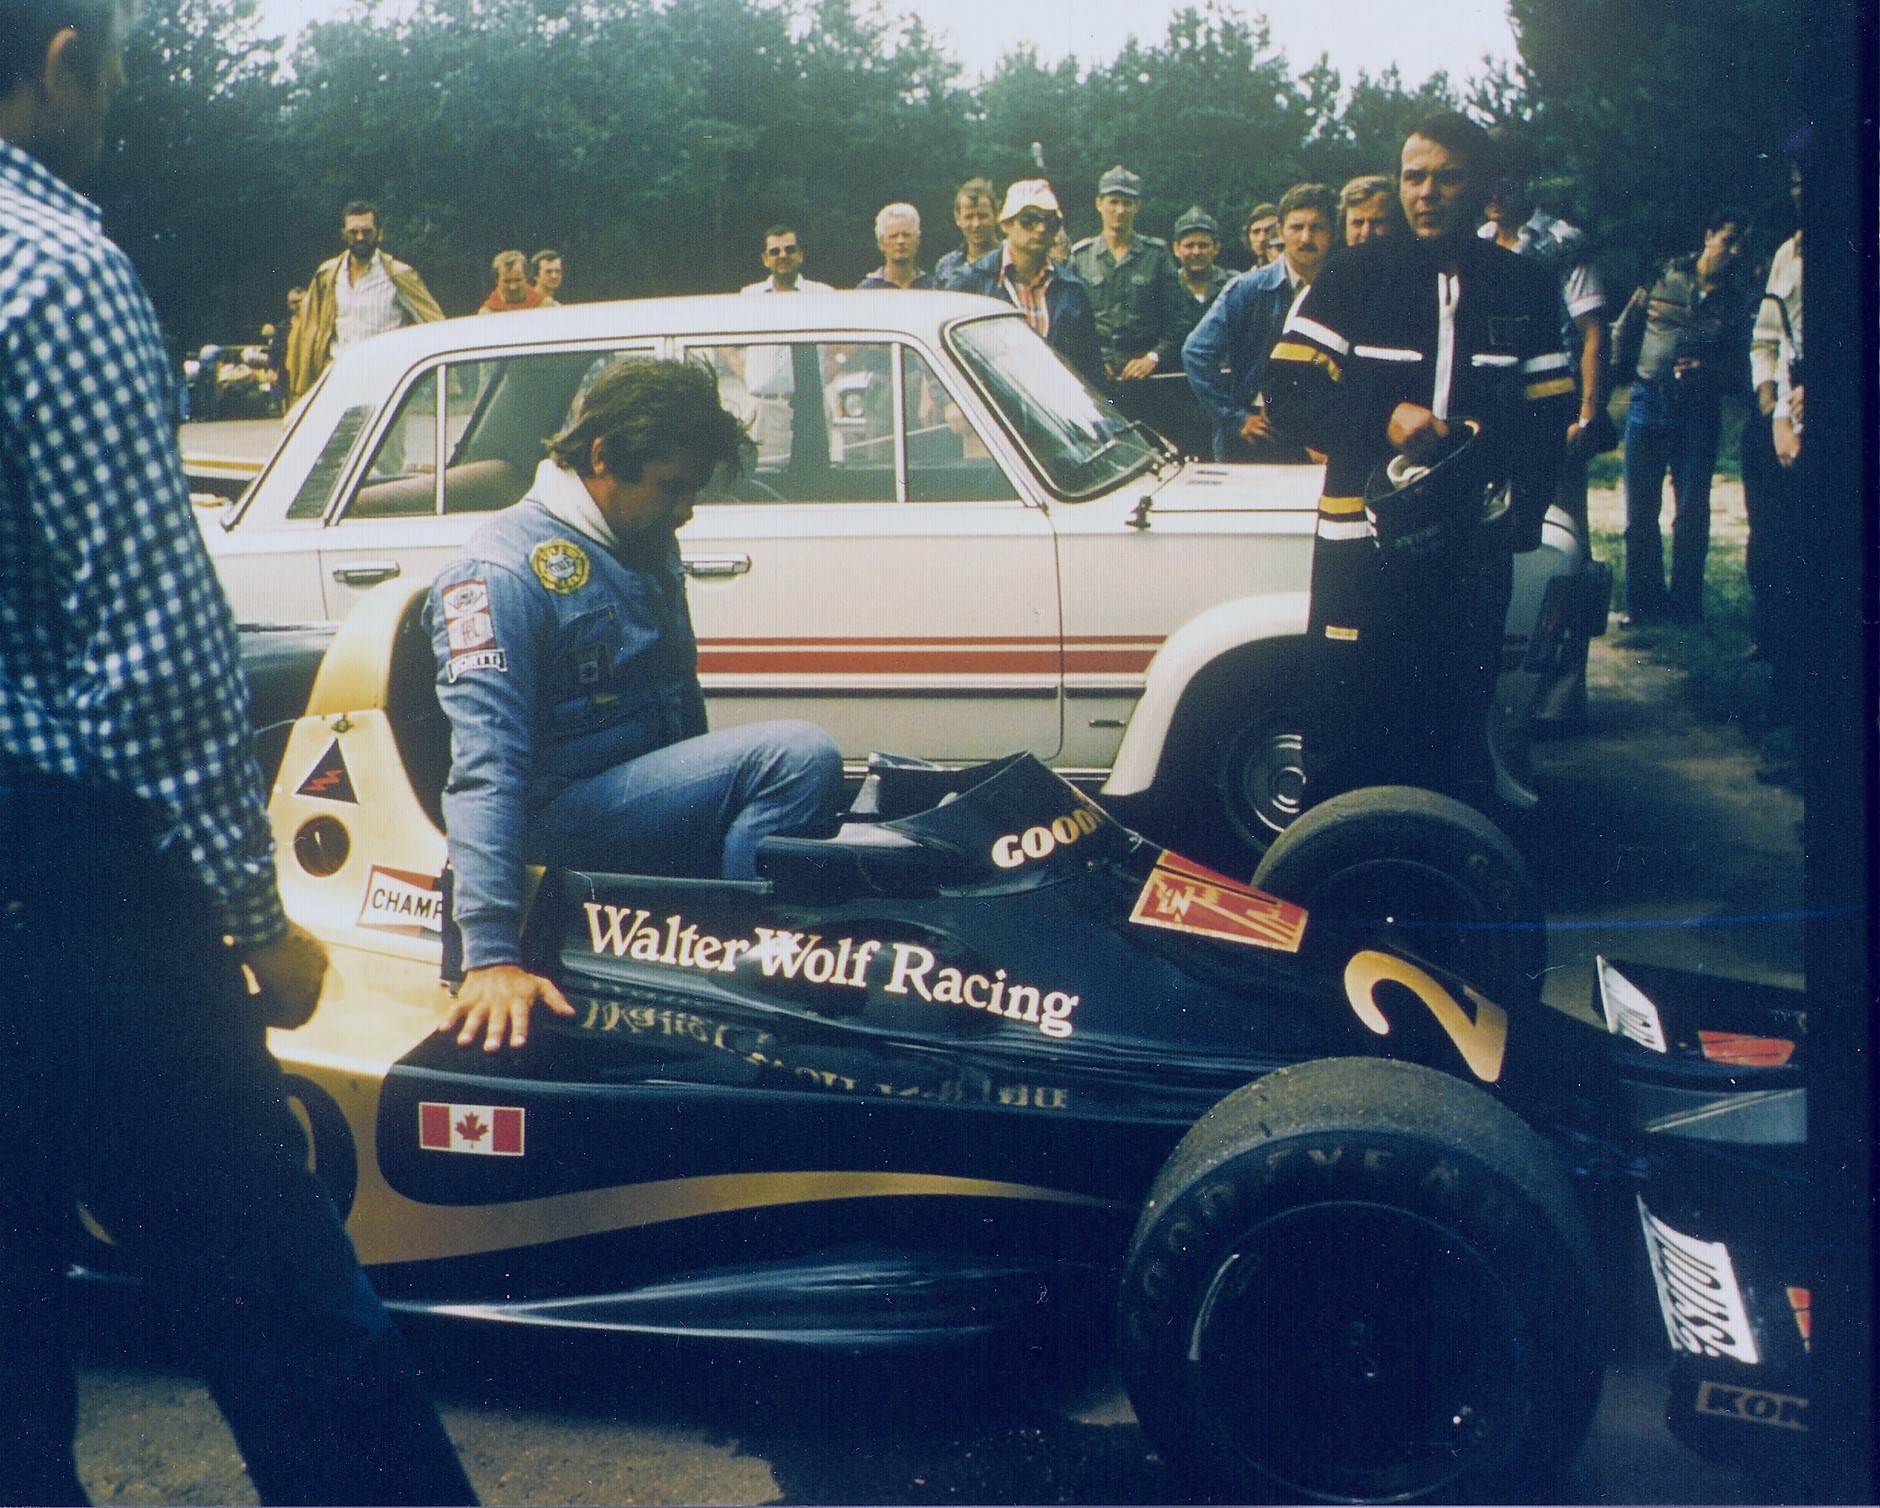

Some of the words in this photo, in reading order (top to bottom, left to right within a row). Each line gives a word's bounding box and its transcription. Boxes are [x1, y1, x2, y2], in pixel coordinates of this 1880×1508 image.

[372, 887, 442, 920] CHAMP
[583, 902, 750, 972] Walter
[754, 927, 881, 988] Wolf
[884, 943, 1079, 1038] Racing
[1344, 950, 1507, 1083] 2
